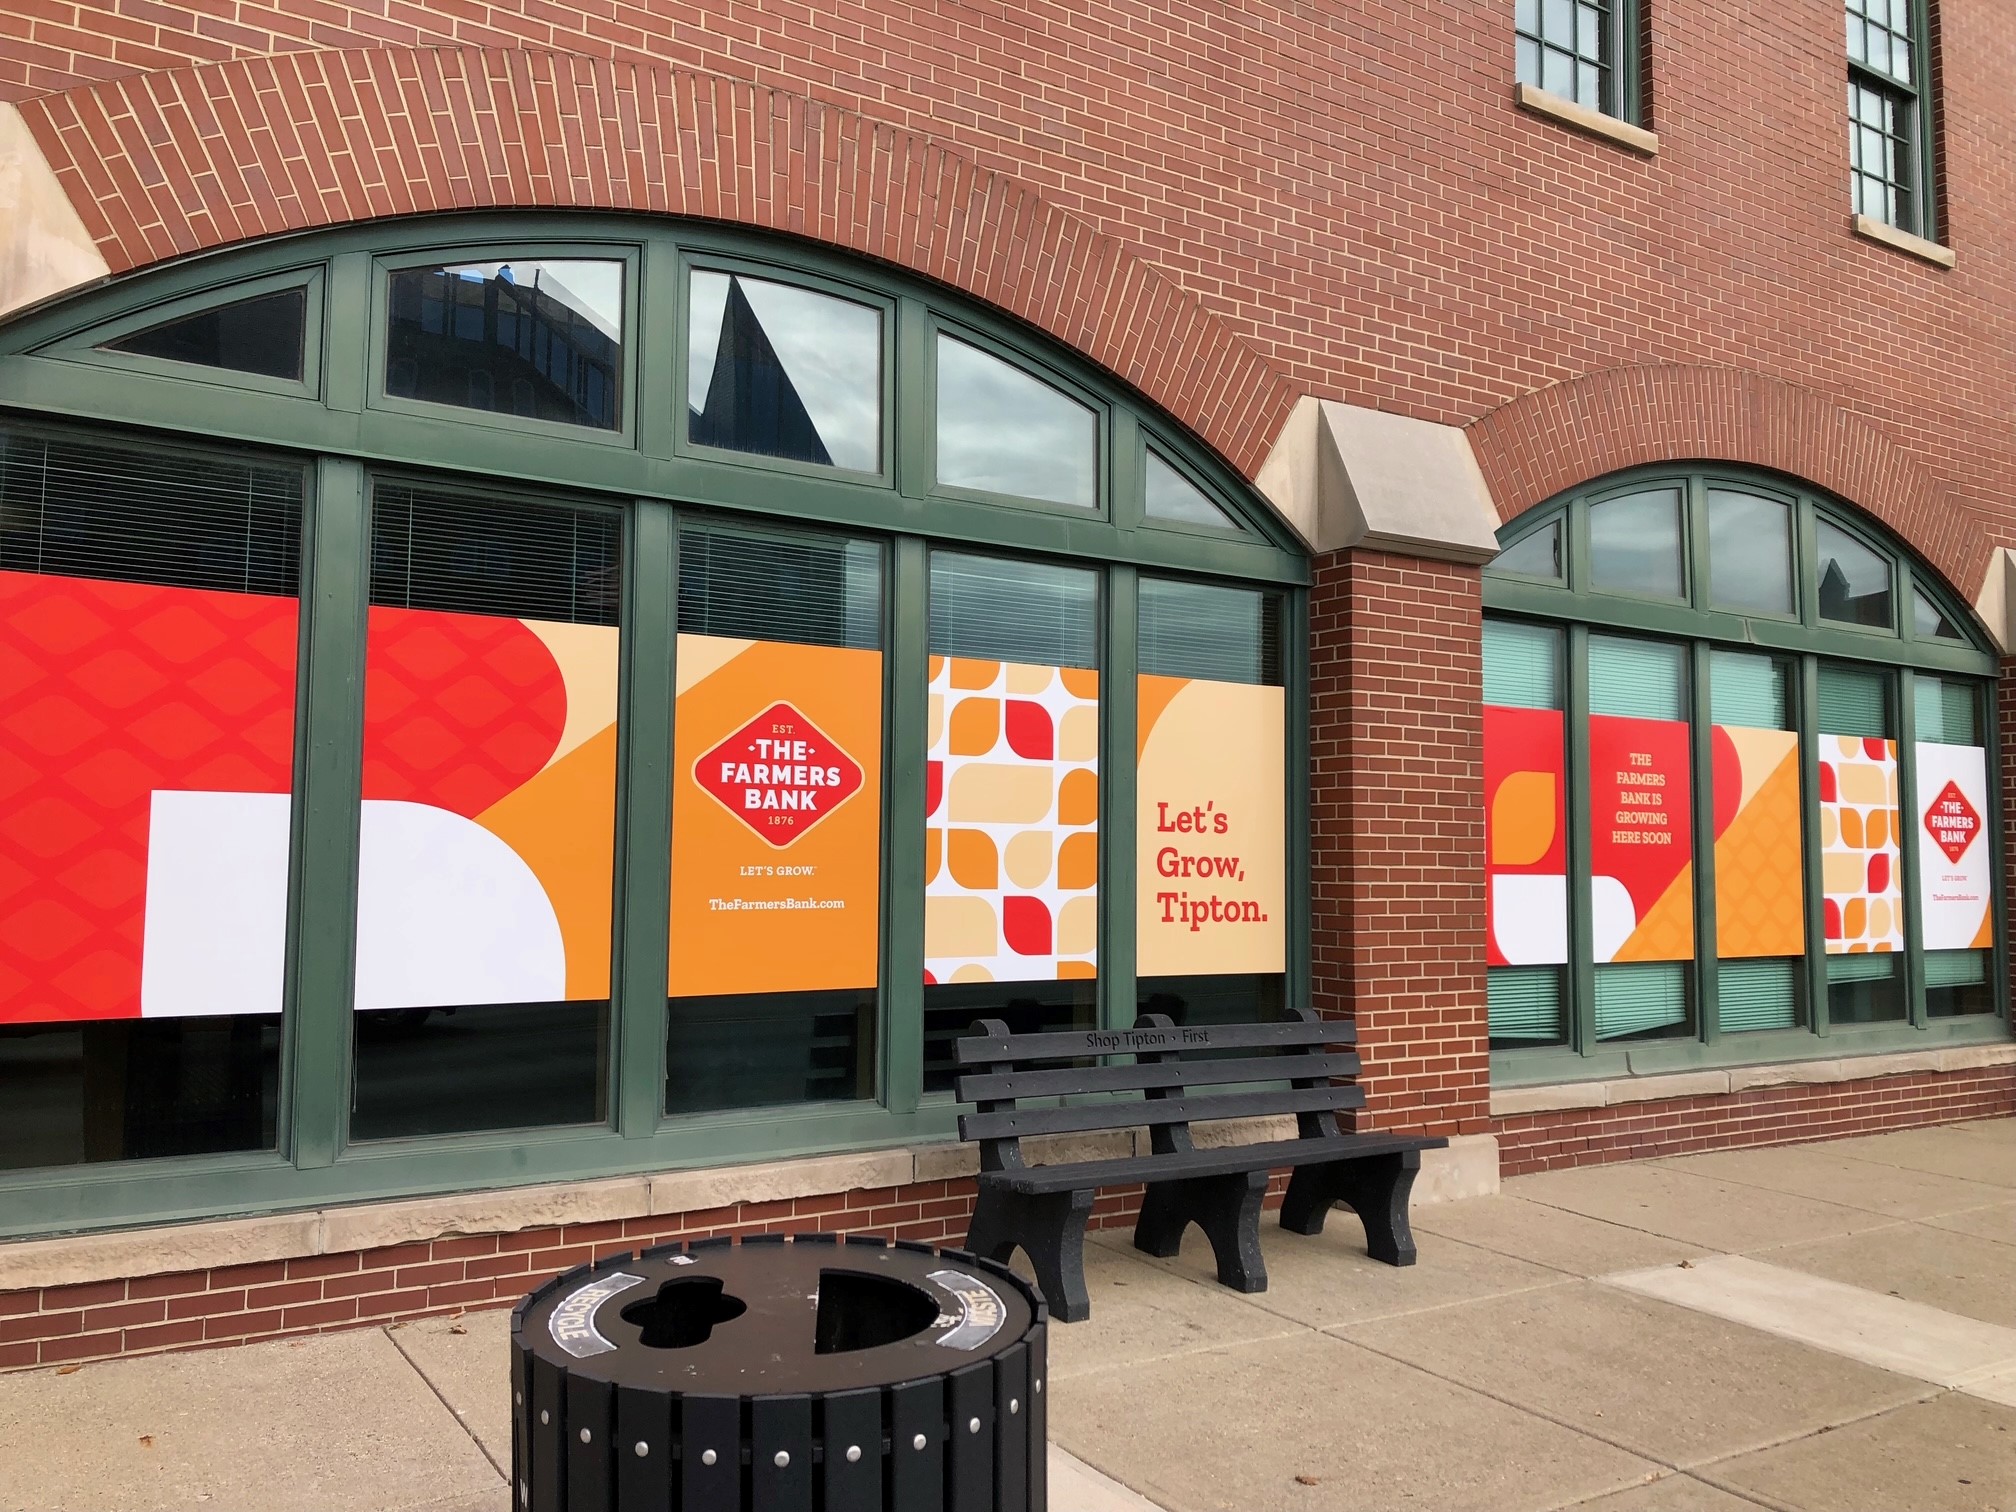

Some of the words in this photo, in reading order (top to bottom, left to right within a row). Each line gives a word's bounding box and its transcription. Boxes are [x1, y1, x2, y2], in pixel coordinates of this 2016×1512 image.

[772, 724, 795, 735] EST.
[756, 739, 807, 761] THE
[1630, 753, 1652, 766] THE
[721, 762, 841, 786] FARMERS
[1616, 771, 1666, 786] FARMERS
[745, 789, 817, 811] BANK
[1621, 792, 1651, 805] BANK
[1652, 793, 1662, 805] IS
[1943, 801, 1962, 814] THE
[768, 816, 794, 825] 1876
[1157, 801, 1228, 834] Let's
[1616, 811, 1668, 825] GROWING
[1932, 815, 1974, 829] FARMERS
[1612, 831, 1641, 844] HERE
[1642, 832, 1672, 844] SOON
[1941, 830, 1966, 843] BANK
[740, 866, 774, 876] LET'S
[1157, 847, 1244, 881] Grow,
[709, 898, 845, 911] TheFarmersBank.com
[1157, 892, 1268, 932] Tipton.
[1086, 1033, 1120, 1050] Shop
[1123, 1031, 1166, 1049] Tipton
[1182, 1029, 1210, 1043] First
[557, 1288, 611, 1341] RECYCLE
[968, 1289, 998, 1327] WASTE
